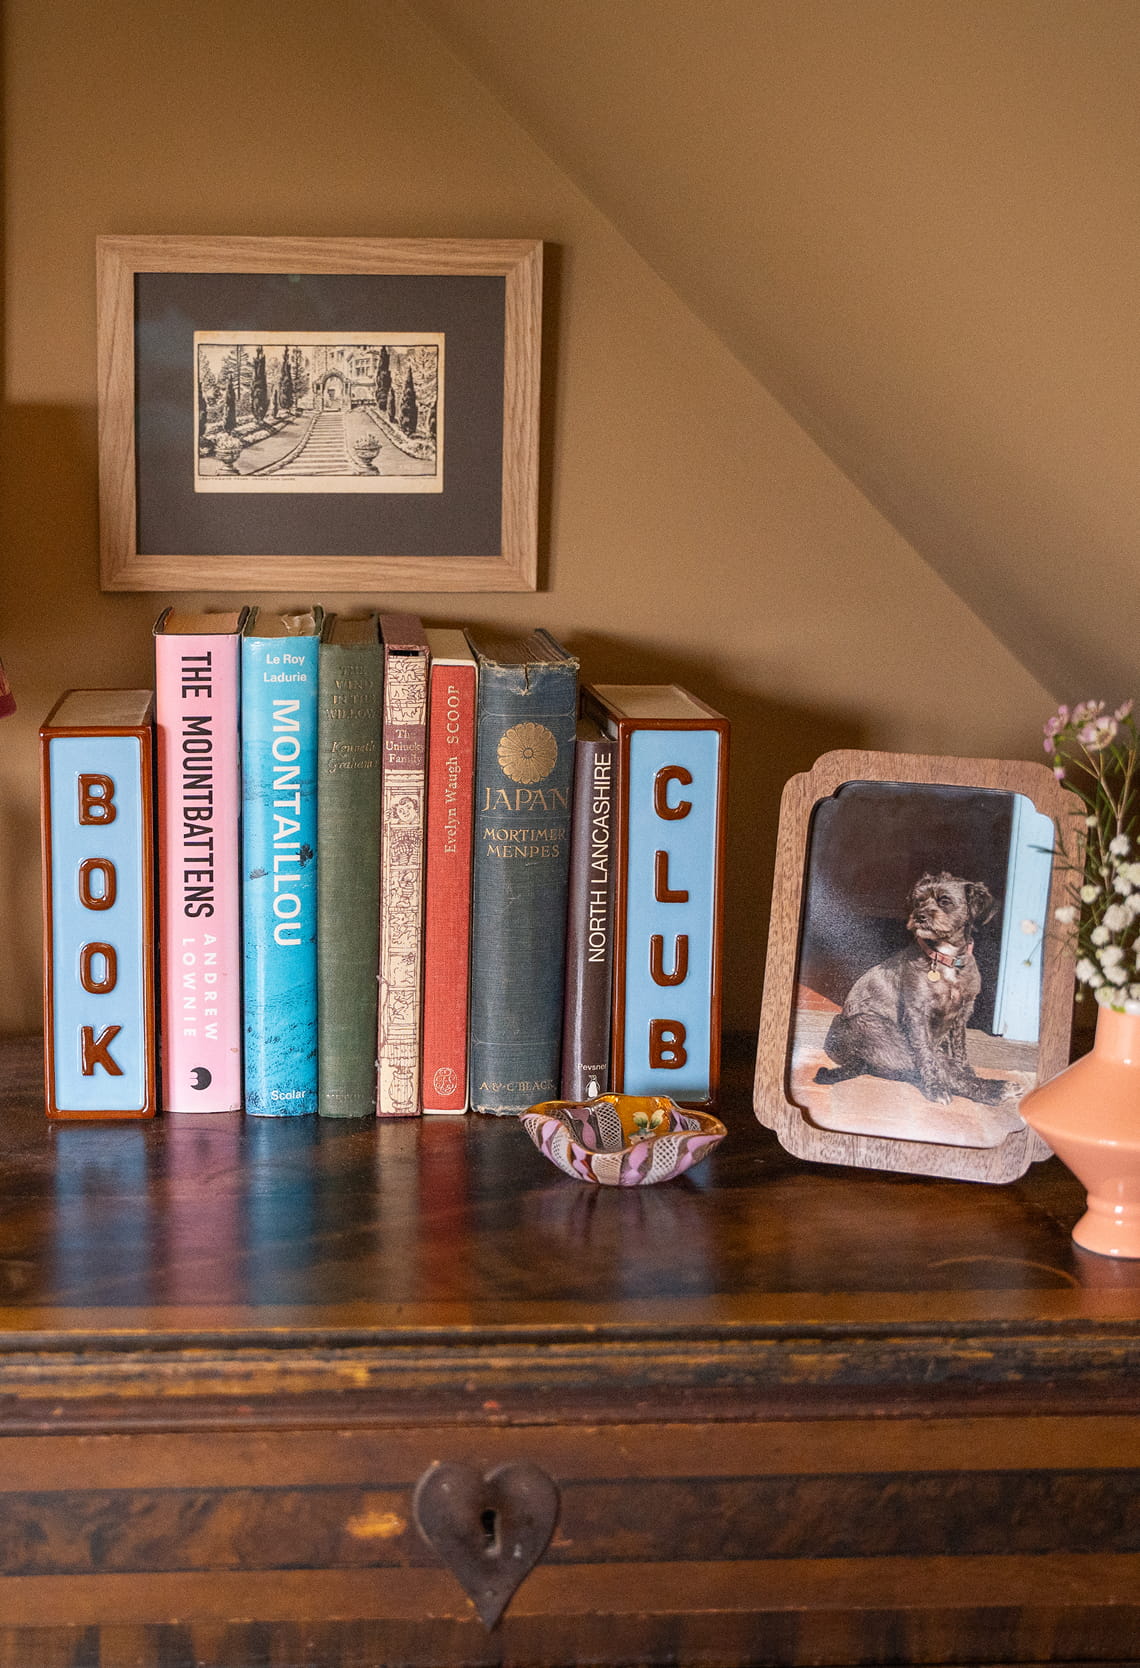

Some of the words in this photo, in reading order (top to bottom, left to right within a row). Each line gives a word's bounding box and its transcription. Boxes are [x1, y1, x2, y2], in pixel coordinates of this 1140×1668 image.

[181, 650, 213, 699] THE
[263, 671, 308, 683] Ladurie
[266, 653, 281, 665] Le
[282, 653, 306, 667] Roy
[326, 708, 378, 720] WILLOW
[446, 685, 461, 745] SCOOP
[331, 741, 377, 753] Kenneth
[388, 753, 423, 766] Family
[444, 756, 462, 804] Waugh
[481, 787, 569, 812] JAPAN
[181, 715, 215, 919] MOUNTBATTENS
[271, 699, 302, 946] MONTAILLOU
[444, 807, 461, 853] Evelyn
[482, 827, 566, 843] MORTIMER
[590, 752, 612, 884] LANCASHIRE
[486, 843, 560, 858] MENPES
[77, 773, 123, 1077] BOOK
[588, 890, 608, 963] NORTH
[648, 764, 693, 1070] CLUB
[182, 937, 198, 1038] LOWNIE
[203, 933, 219, 1041] ANDREW
[577, 1063, 608, 1071] Pevsner
[271, 1089, 306, 1101] Scolar
